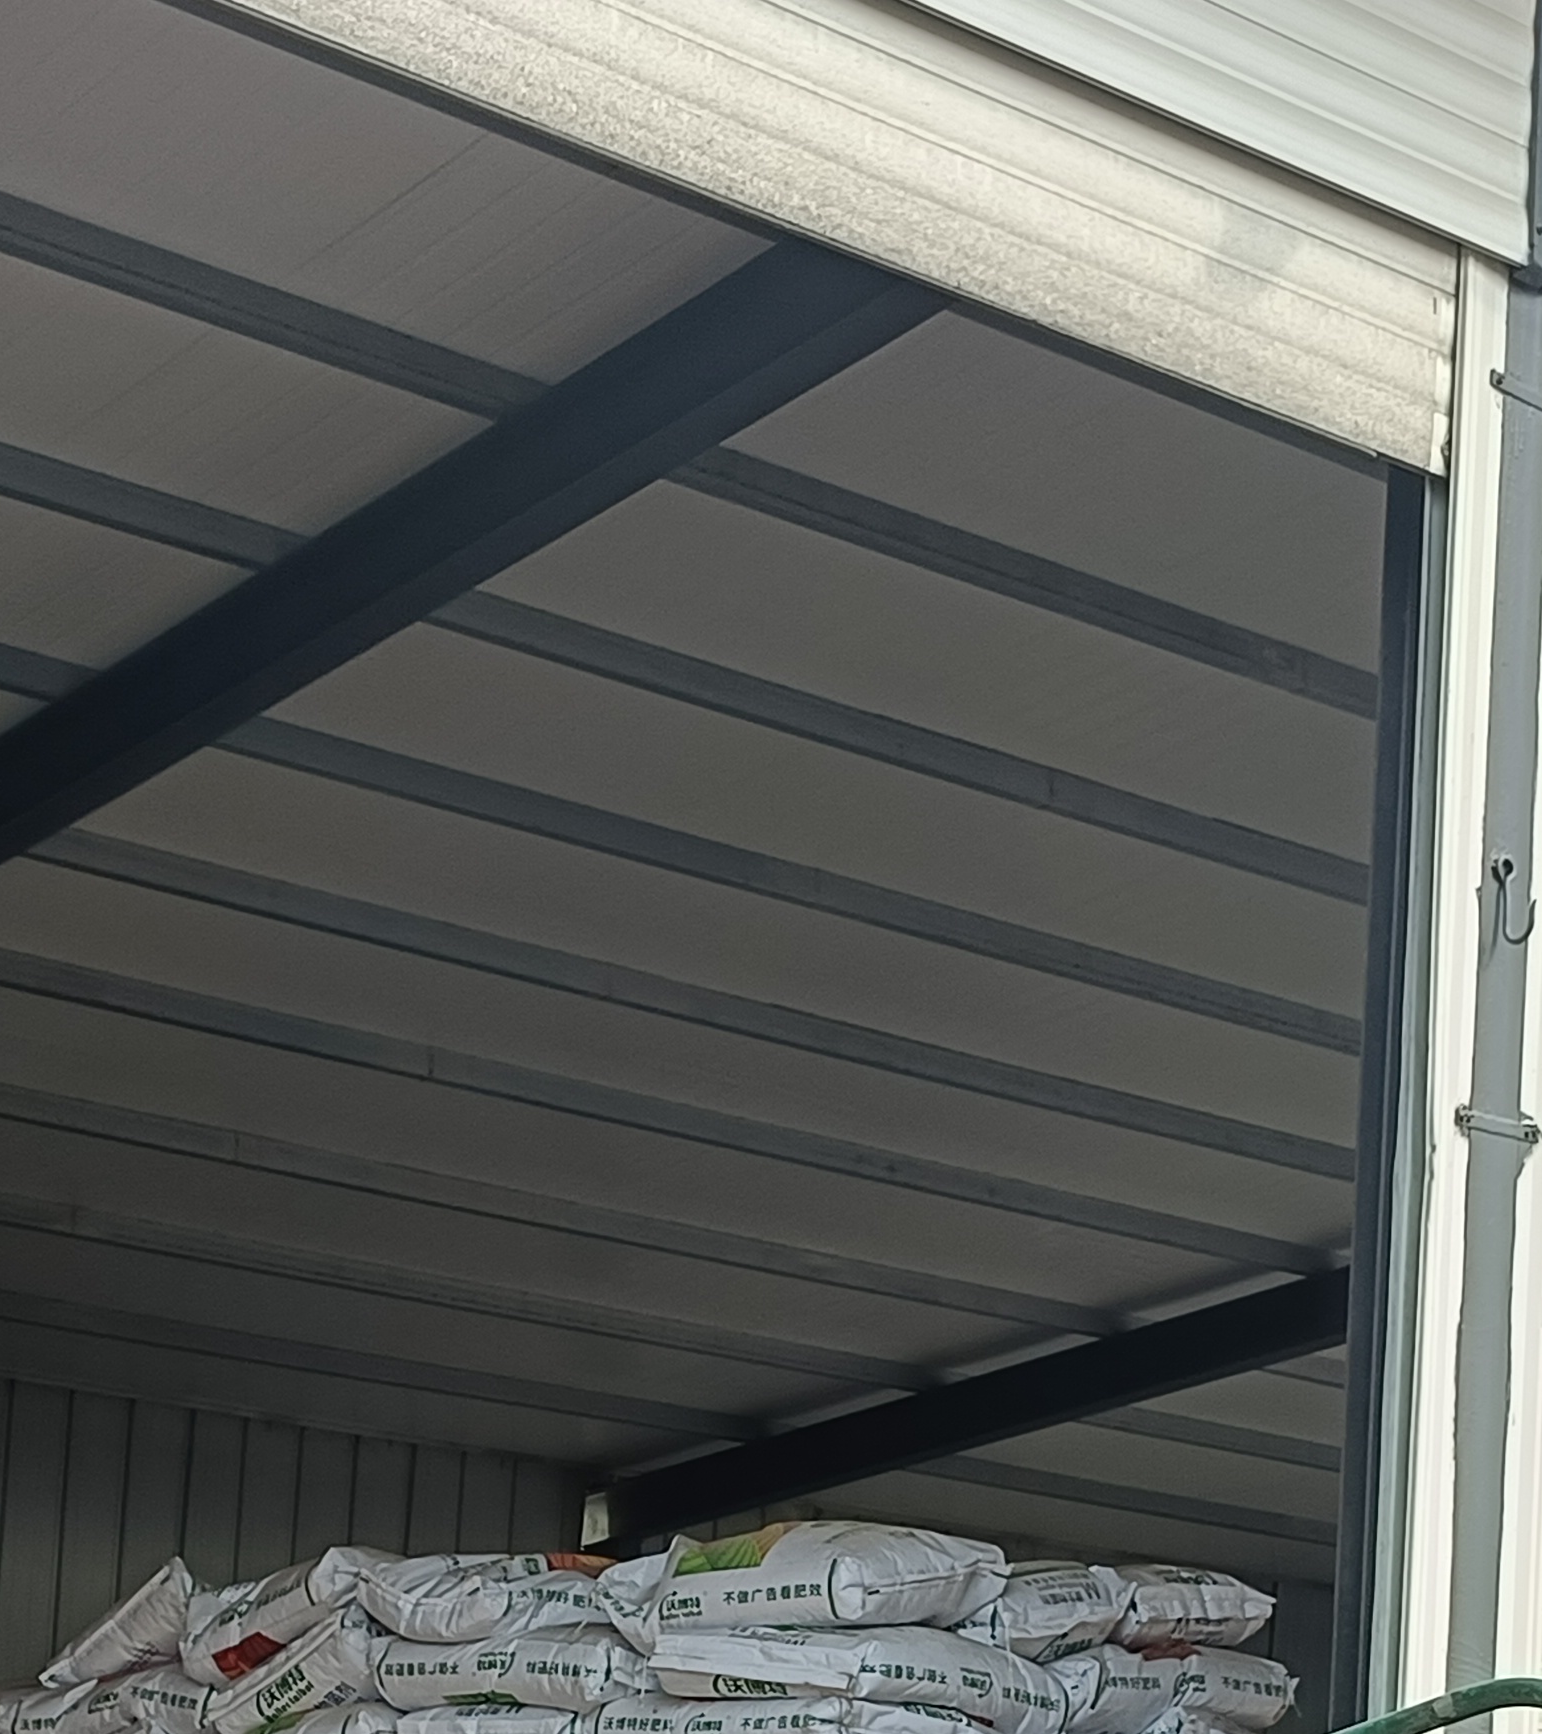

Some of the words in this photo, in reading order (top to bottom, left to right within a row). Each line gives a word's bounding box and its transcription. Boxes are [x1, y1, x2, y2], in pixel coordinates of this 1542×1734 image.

[722, 1583, 823, 1605] 不做广告看肥效
